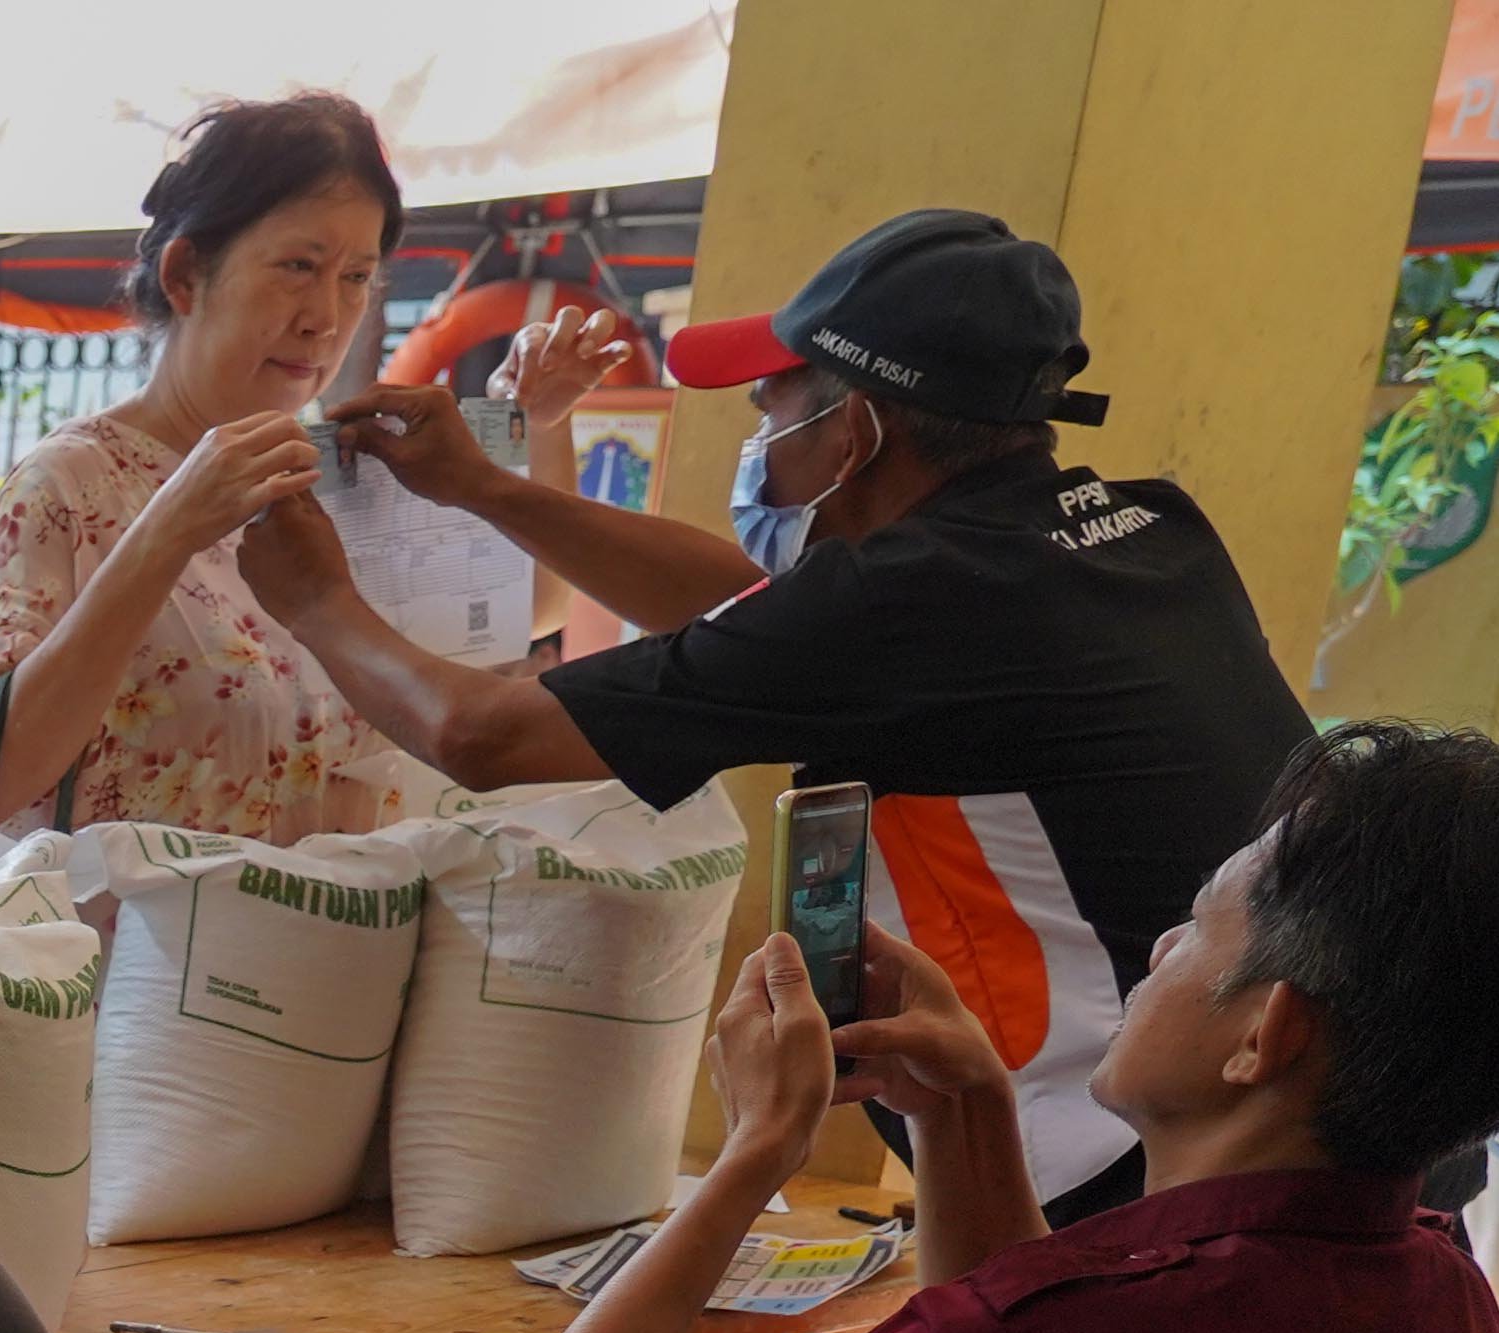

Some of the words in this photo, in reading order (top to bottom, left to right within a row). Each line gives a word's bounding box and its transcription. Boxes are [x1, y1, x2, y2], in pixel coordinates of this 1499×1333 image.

[811, 327, 871, 370] JAKARTA
[870, 356, 924, 389] PUSAT
[1080, 505, 1160, 547] JAKARTA
[239, 861, 379, 928] BANTUAN
